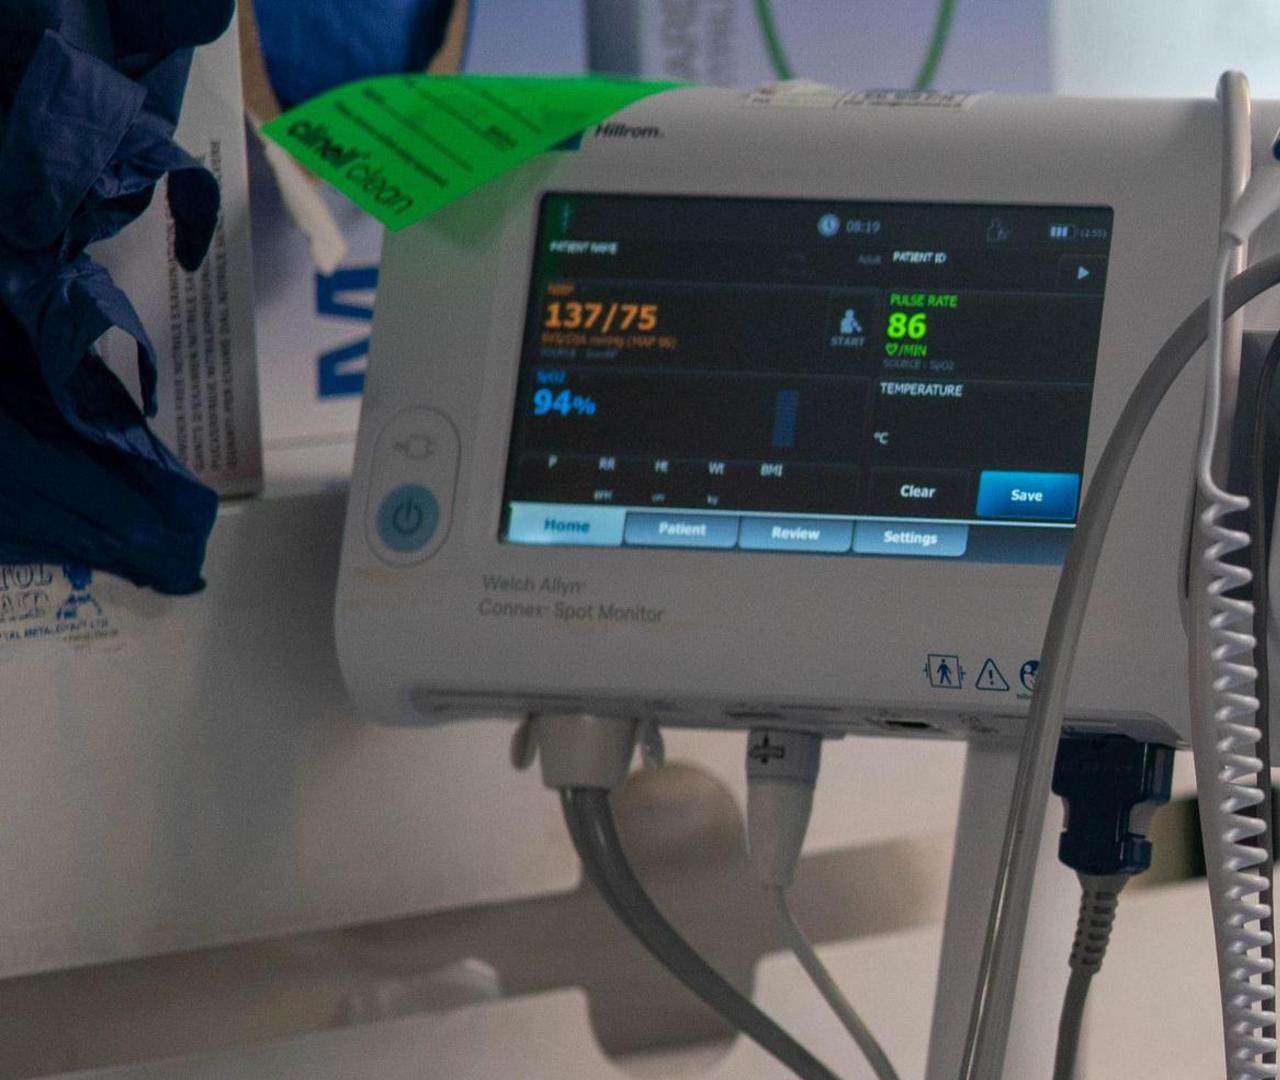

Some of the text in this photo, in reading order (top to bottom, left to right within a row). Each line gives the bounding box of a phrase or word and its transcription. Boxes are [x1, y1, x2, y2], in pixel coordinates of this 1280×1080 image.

[893, 251, 946, 263] PATIENT ID
[890, 293, 958, 309] PULSE RATE
[545, 302, 658, 334] 137/75
[887, 312, 928, 339] 86
[831, 336, 866, 347] START
[880, 382, 964, 397] TEMPERATURE
[533, 388, 597, 416] 94%
[599, 456, 616, 471] RR
[760, 463, 783, 477] BMI
[900, 484, 1043, 502] Clear Save
[544, 518, 938, 546] Home Patient Review Settings
[482, 575, 535, 592] Welch
[554, 602, 593, 621] Spot
[598, 603, 666, 623] Monitor
